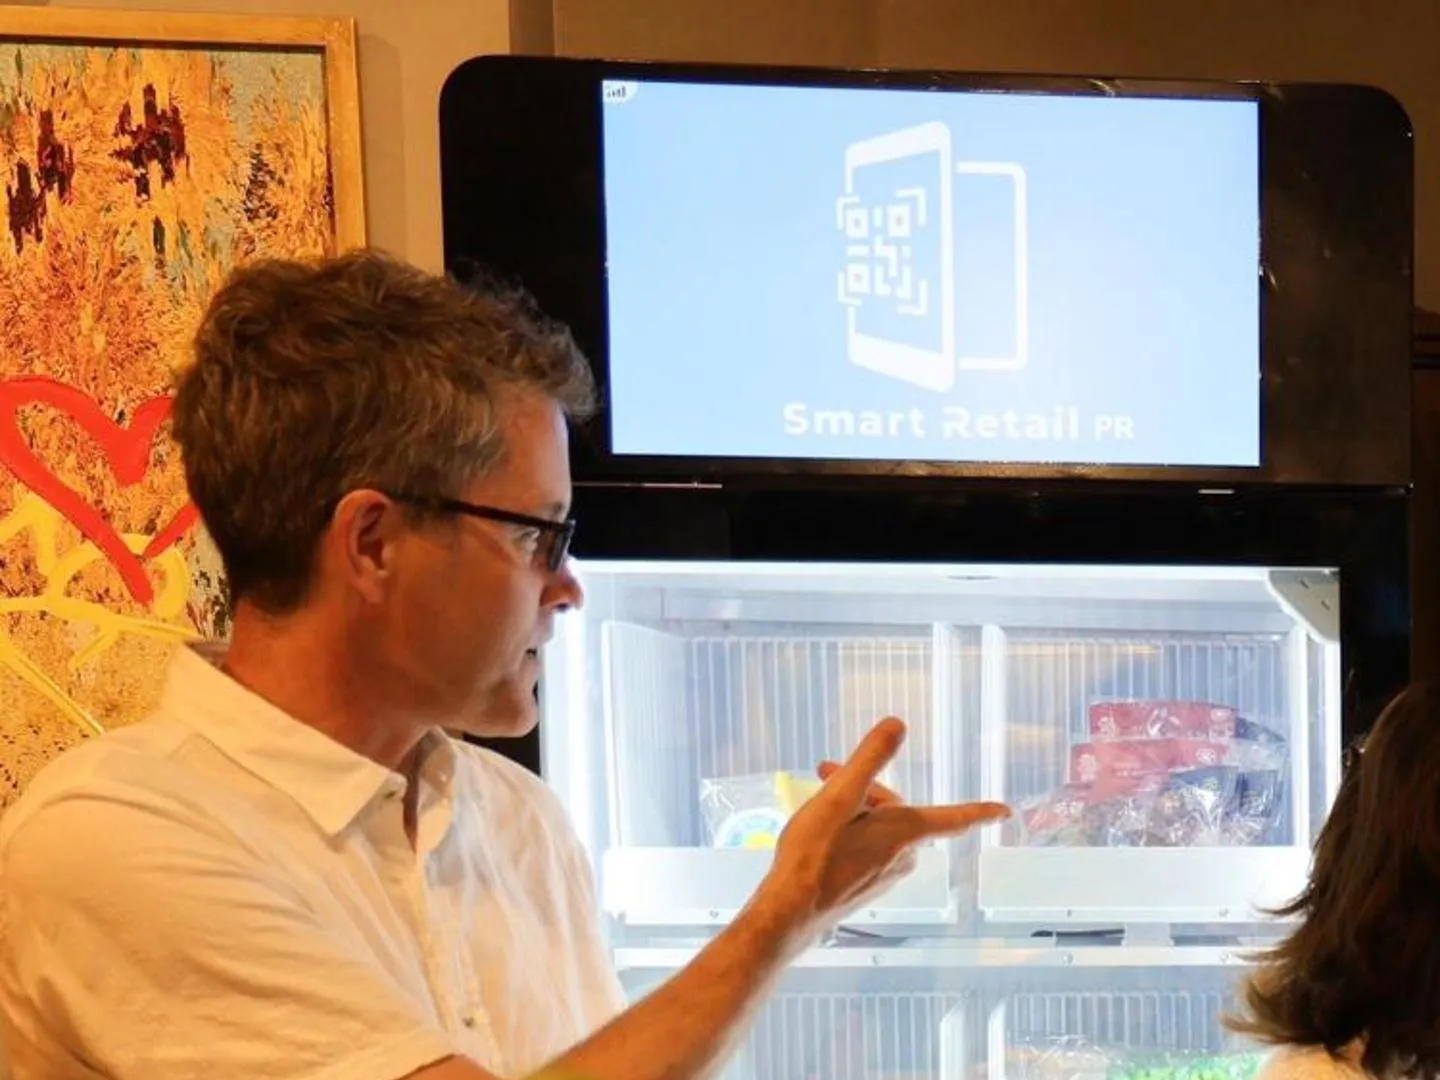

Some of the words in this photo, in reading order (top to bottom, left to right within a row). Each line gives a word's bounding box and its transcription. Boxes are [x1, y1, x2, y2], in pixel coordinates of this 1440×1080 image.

[782, 402, 925, 438] Smart
[942, 404, 1080, 440] Retail
[1094, 414, 1135, 441] PR
